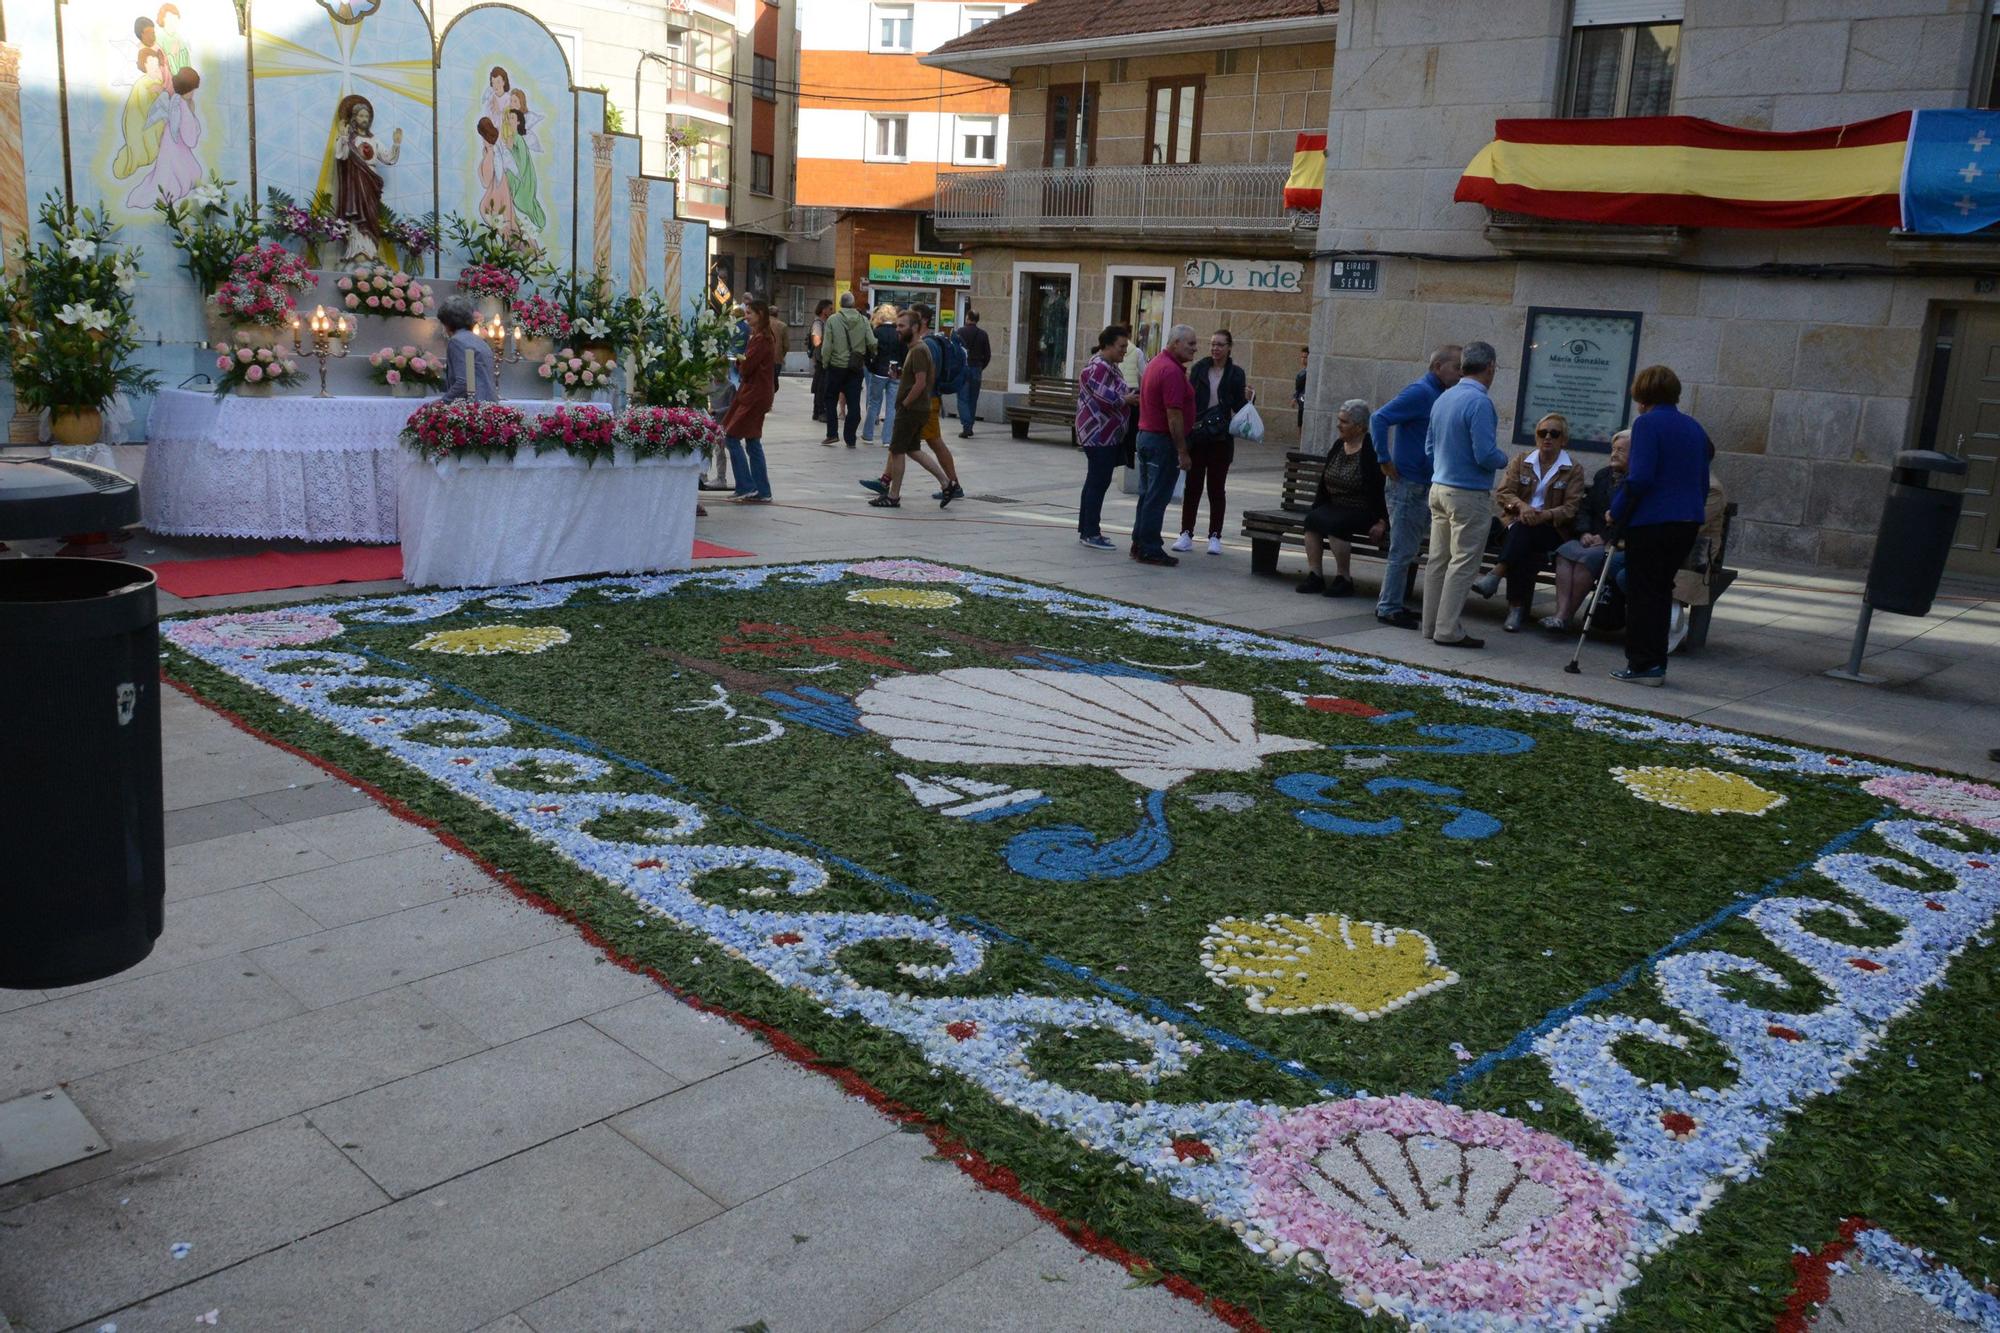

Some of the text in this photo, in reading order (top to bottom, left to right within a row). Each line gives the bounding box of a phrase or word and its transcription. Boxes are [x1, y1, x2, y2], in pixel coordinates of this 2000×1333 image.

[895, 257, 932, 273] pastoriza
[940, 258, 966, 271] calvar
[1346, 262, 1370, 270] EIRADO
